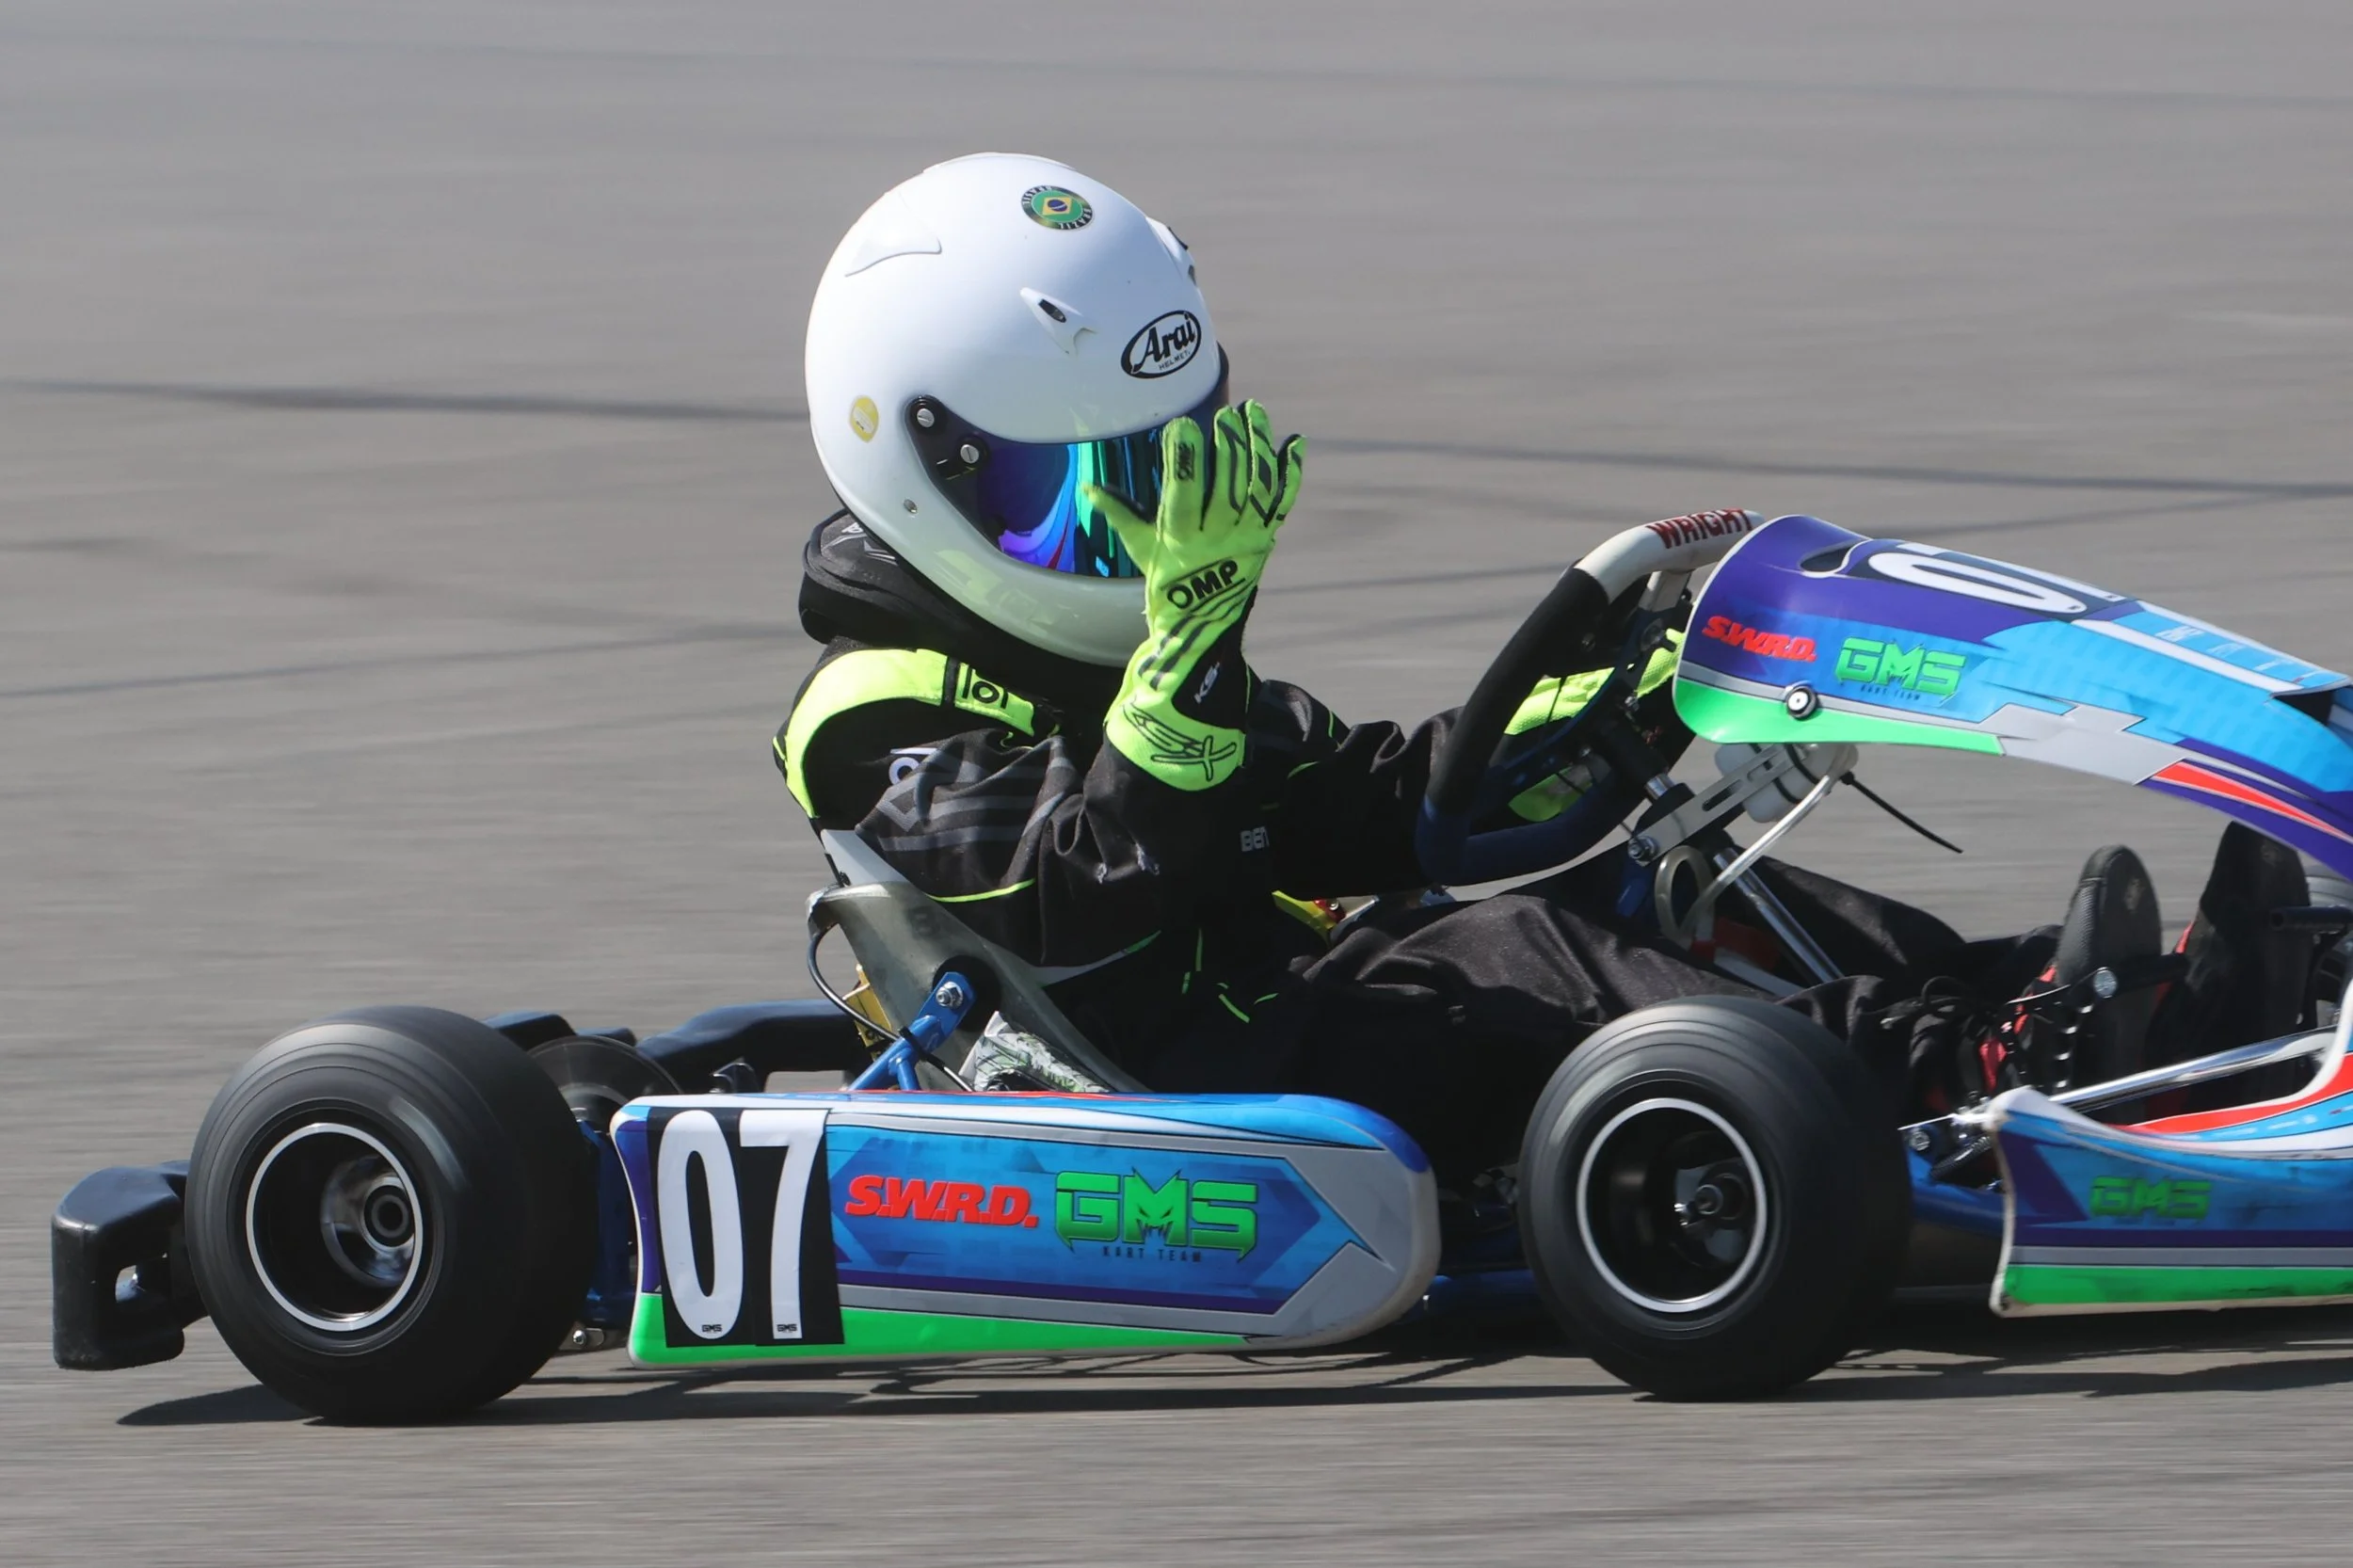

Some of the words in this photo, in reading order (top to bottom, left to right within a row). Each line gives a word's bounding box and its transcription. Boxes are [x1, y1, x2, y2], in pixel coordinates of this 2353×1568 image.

[1058, 208, 1092, 230] BRAZIL
[1132, 312, 1196, 373] Arai
[1644, 507, 1753, 549] WRIGHT
[1167, 559, 1238, 609] OMP
[1835, 636, 1967, 702] GMS
[657, 1110, 831, 1339] 07
[1055, 1166, 1259, 1263] GMS
[2089, 1176, 2211, 1220] GMS
